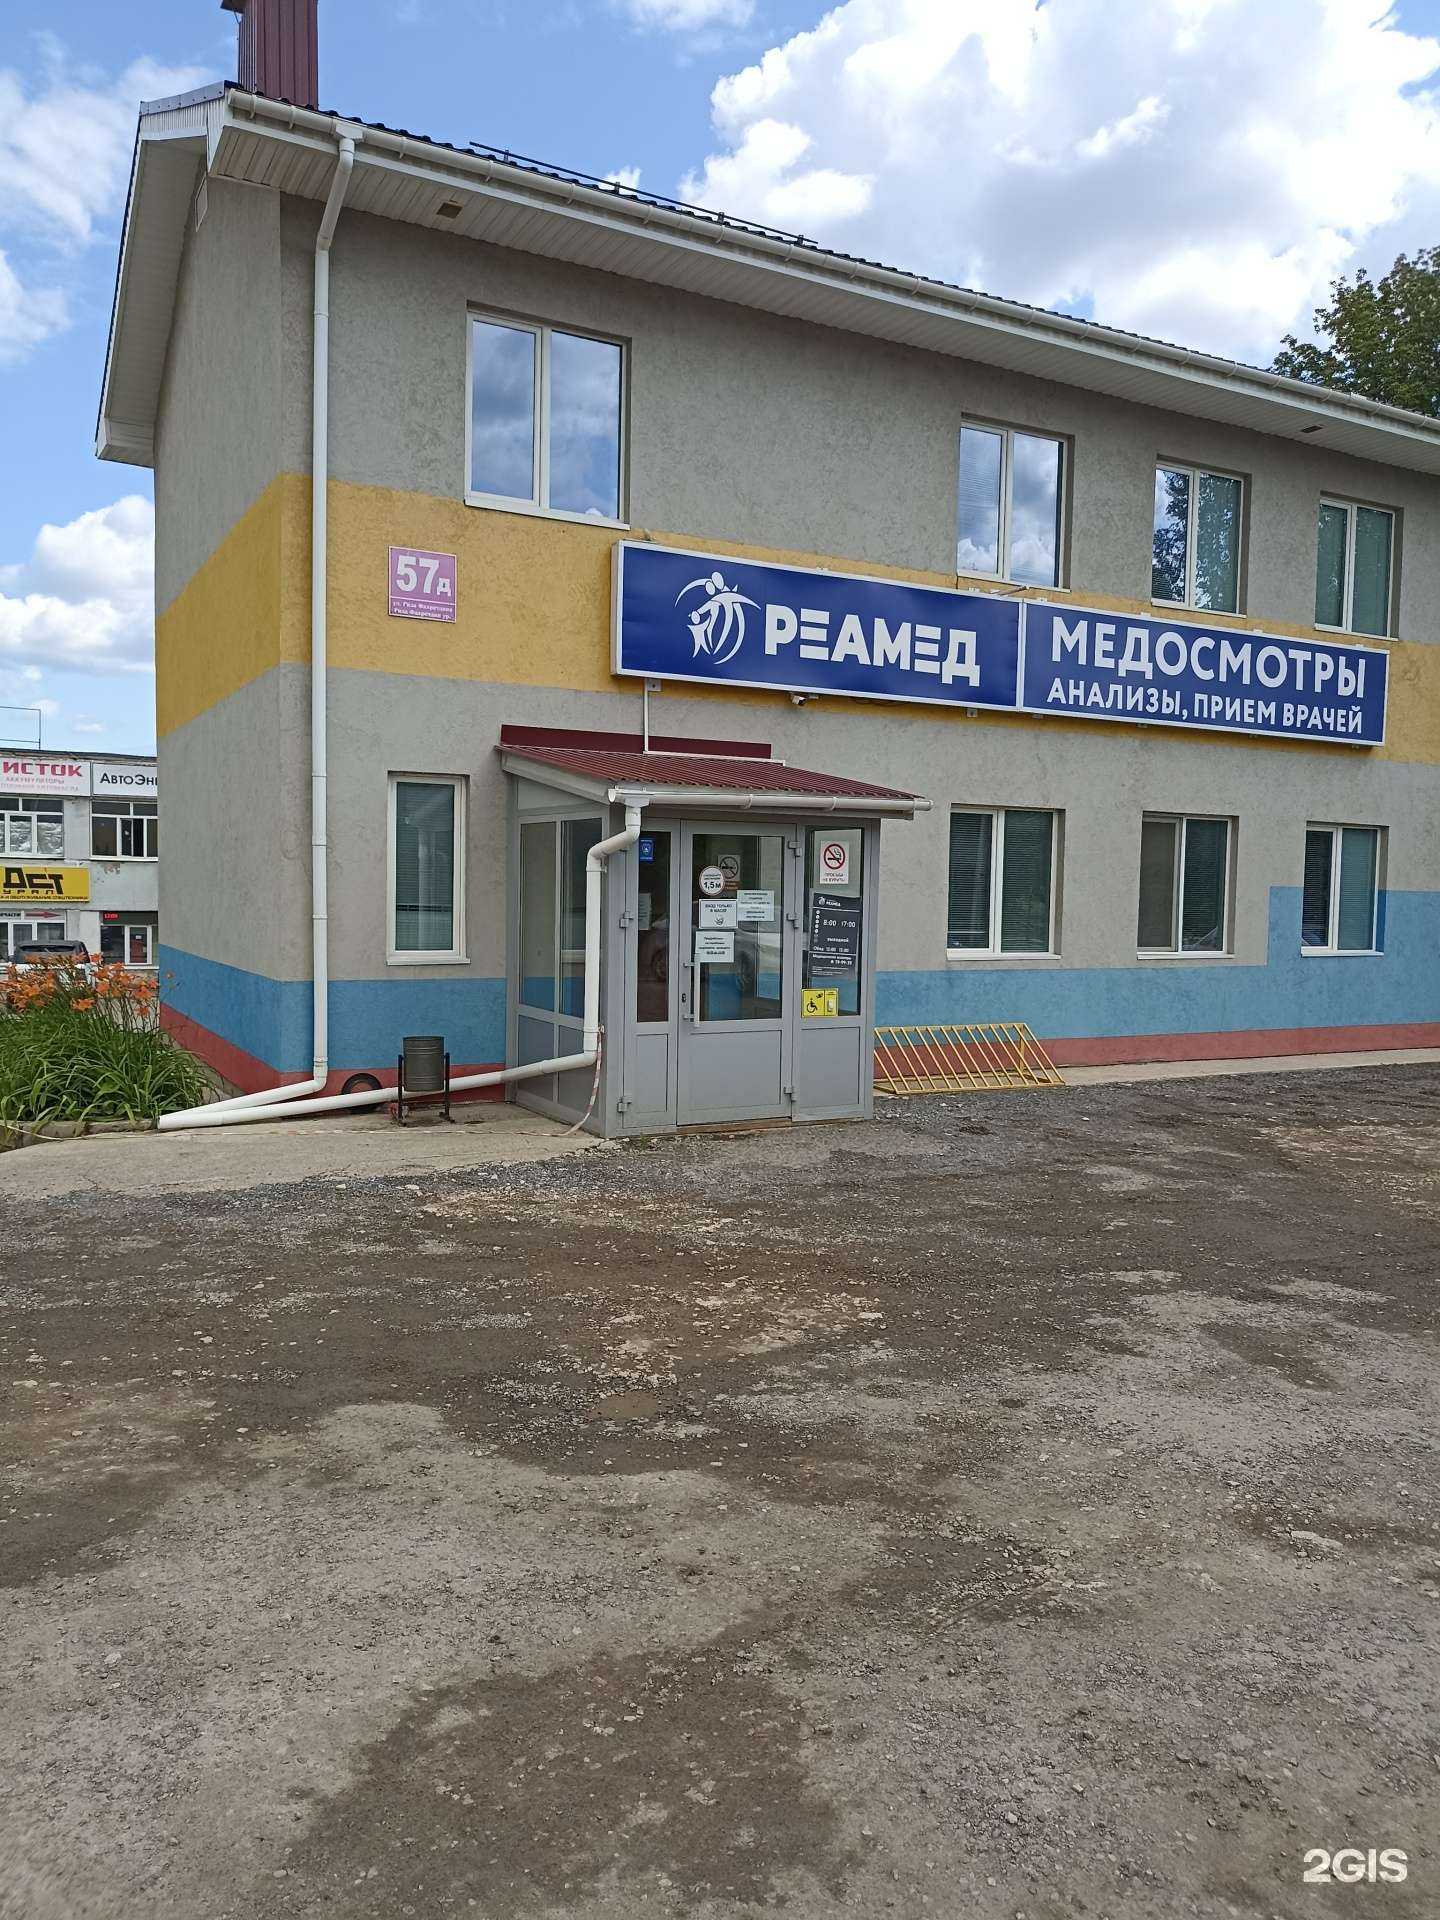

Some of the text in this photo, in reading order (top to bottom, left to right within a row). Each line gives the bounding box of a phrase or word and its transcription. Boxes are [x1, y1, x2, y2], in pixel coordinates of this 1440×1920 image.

[764, 603, 981, 687] РЕАМЕД
[1051, 616, 1367, 699] МЕДОСМОТРЫ
[1046, 677, 1363, 735] АНАЛИЗЫ, ПРИЕМ ВРАЧЕЙ
[3, 762, 83, 777] ИСТОК
[3, 867, 64, 895] ДСТ
